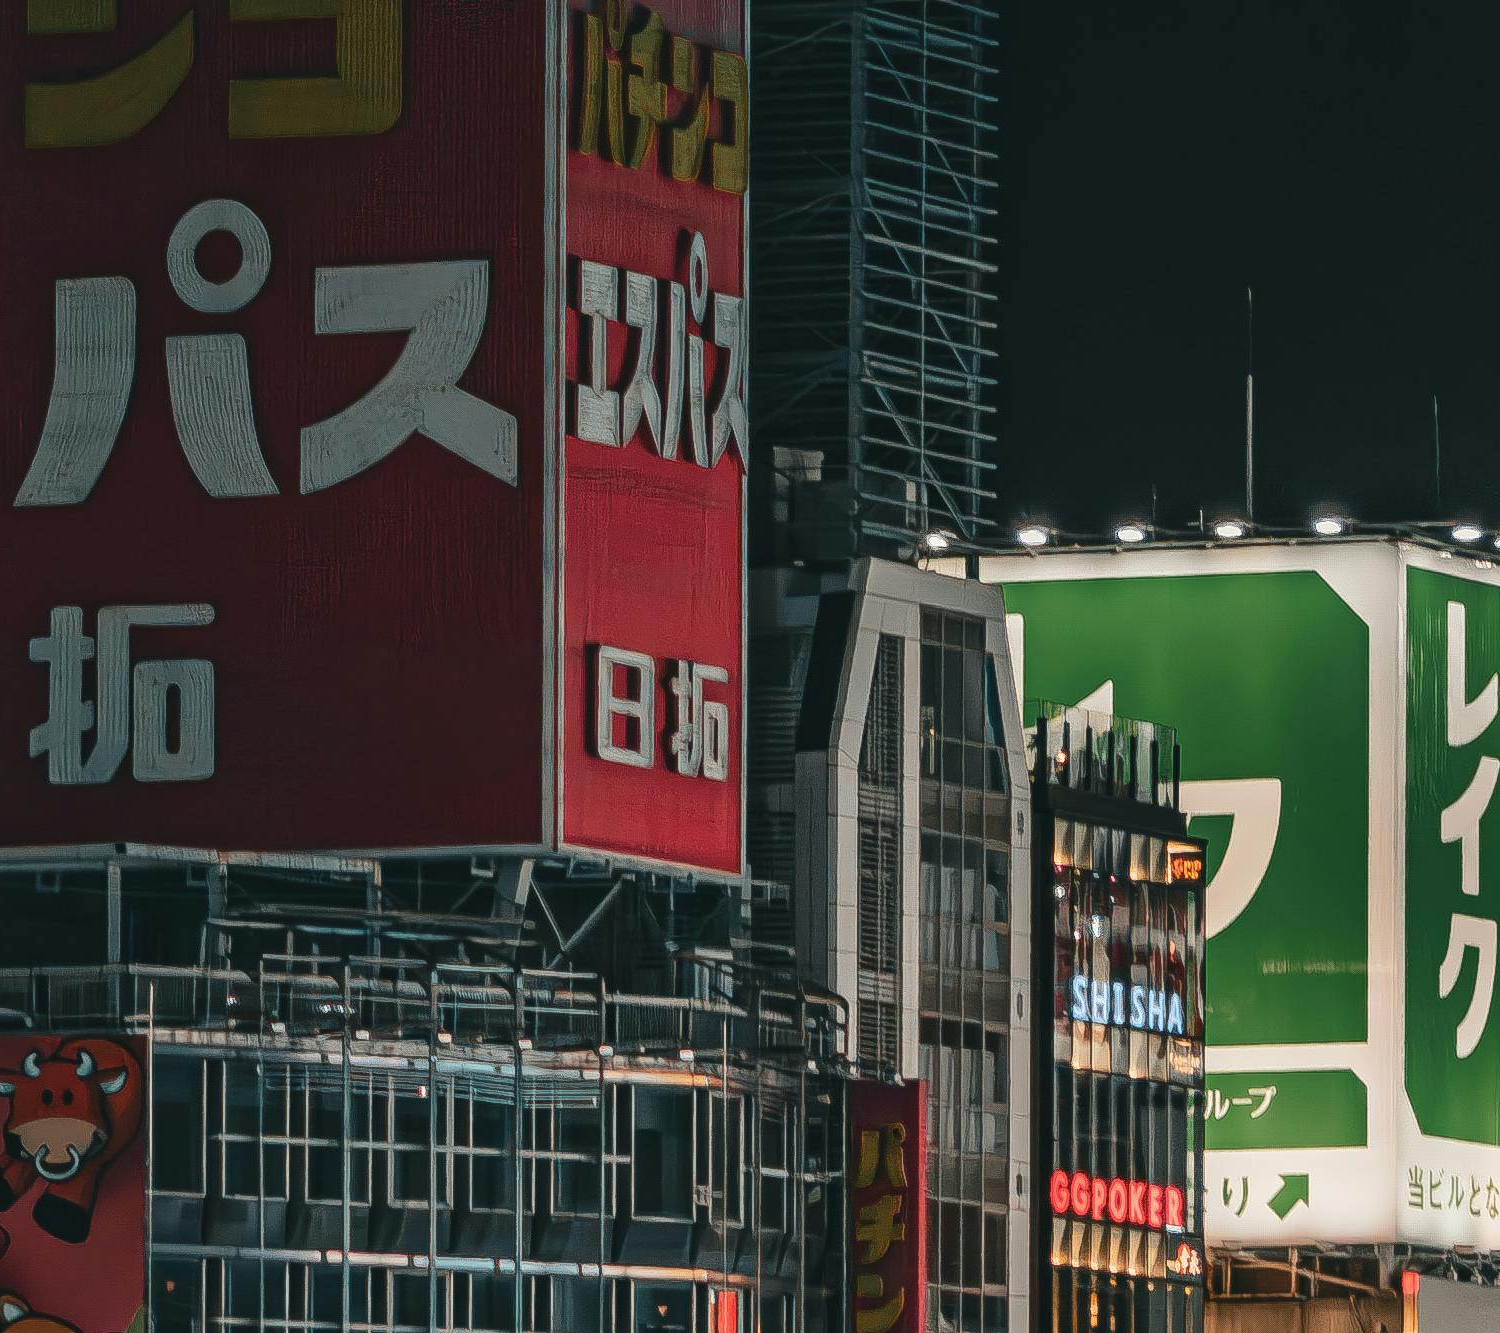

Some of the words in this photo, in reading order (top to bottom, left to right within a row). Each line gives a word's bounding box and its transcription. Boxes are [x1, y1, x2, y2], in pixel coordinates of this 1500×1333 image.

[575, 230, 748, 474] エスパス
[597, 643, 730, 784] 日拓
[1439, 601, 1500, 1060] レイク
[1071, 973, 1183, 1035] SHISHA
[1049, 1168, 1184, 1229] GGPOKER
